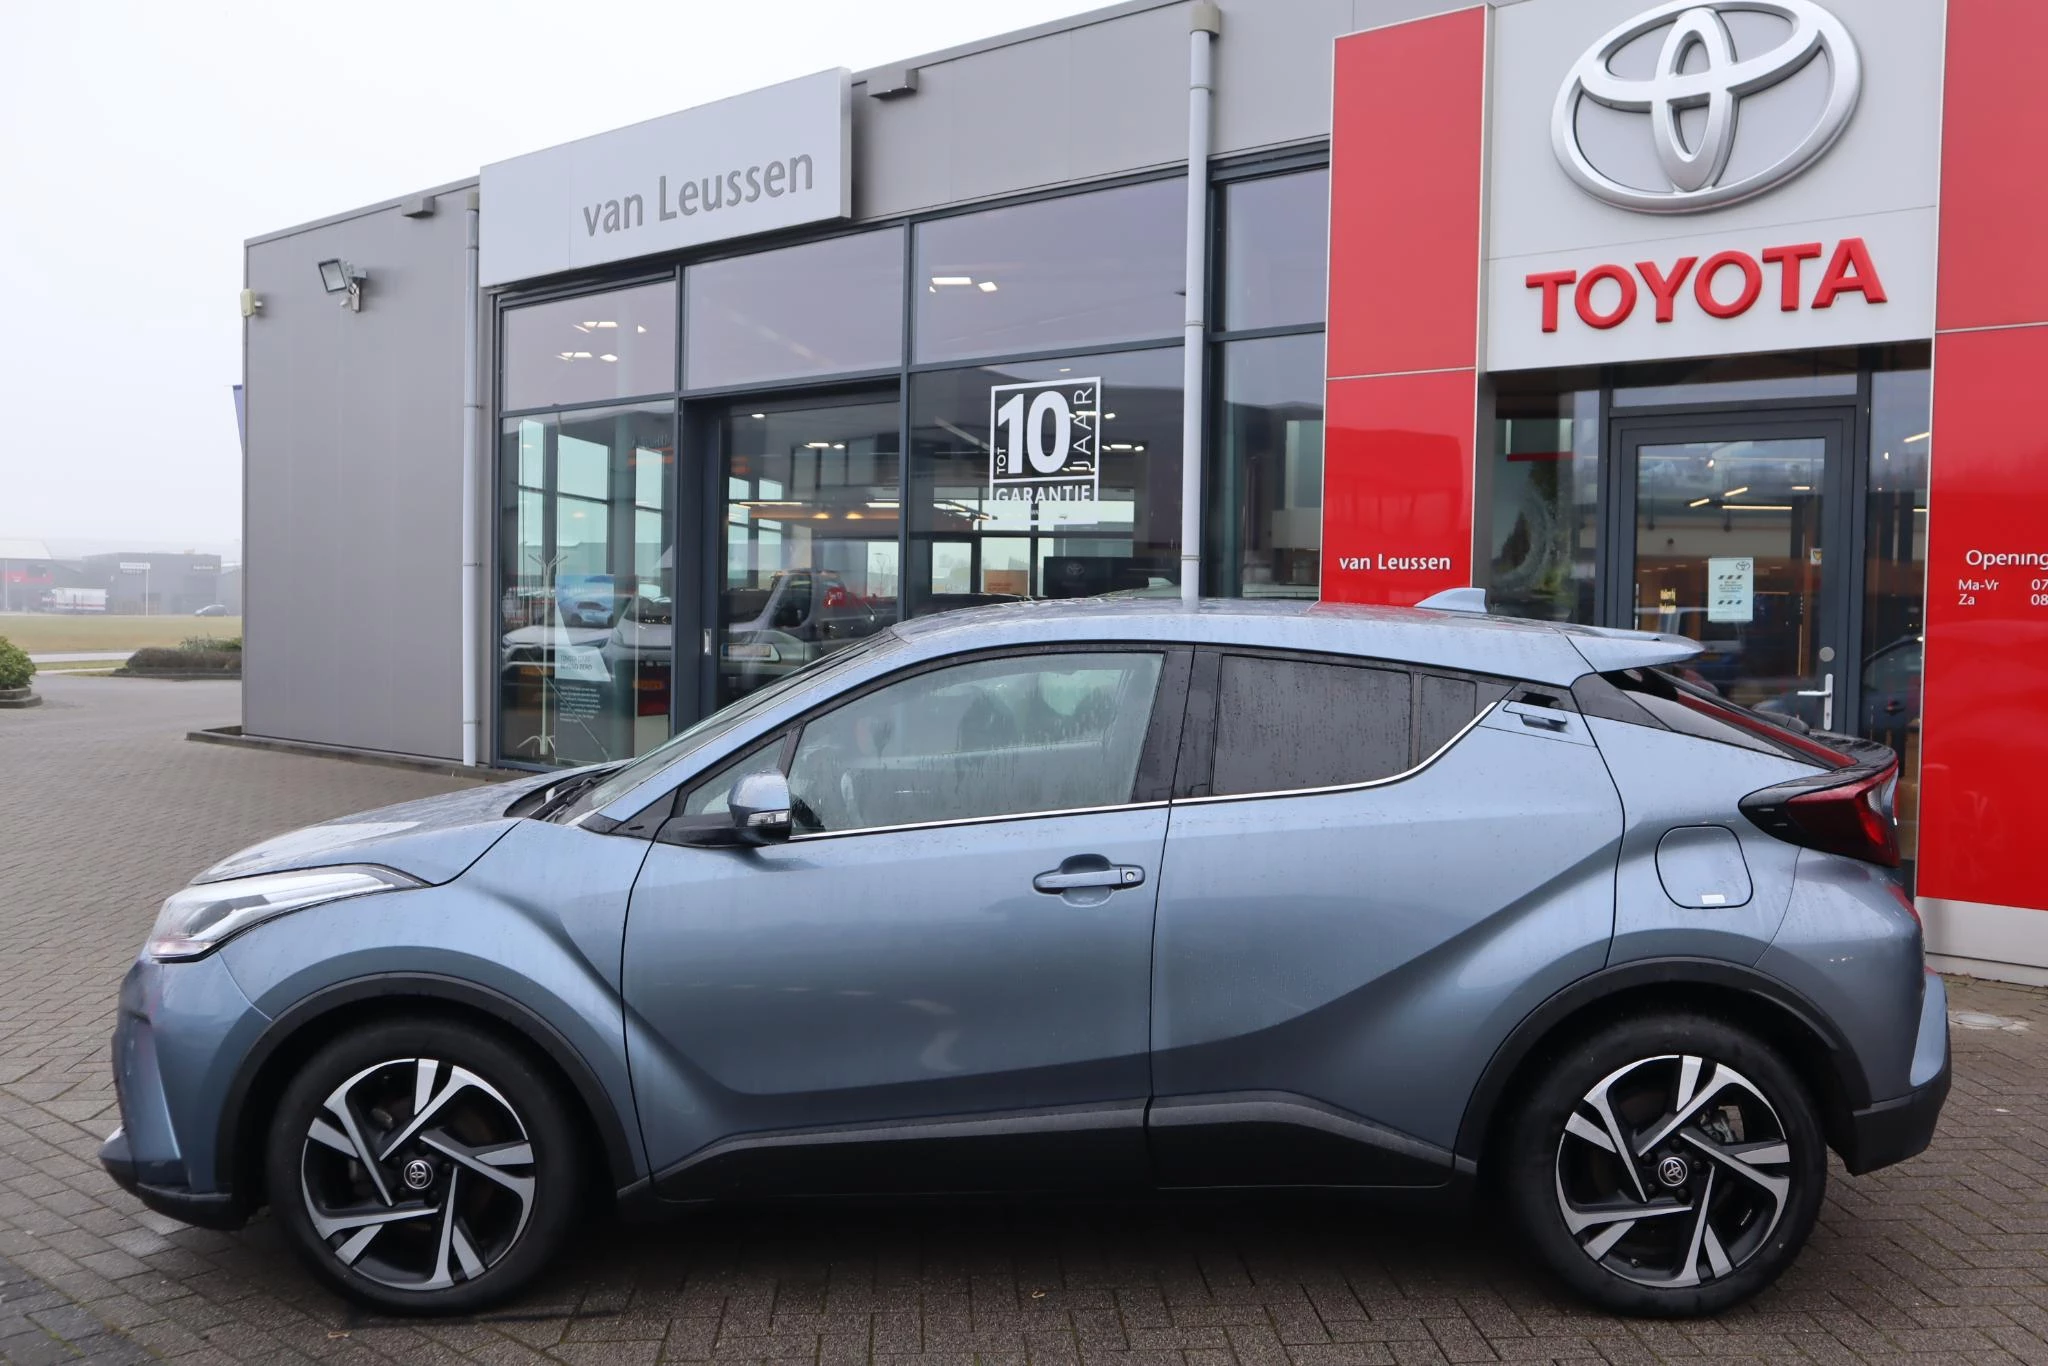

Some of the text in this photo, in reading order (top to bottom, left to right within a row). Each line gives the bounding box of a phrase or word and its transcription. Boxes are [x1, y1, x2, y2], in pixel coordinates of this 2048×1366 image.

[583, 154, 813, 237] van Leussen
[1525, 236, 1888, 333] TOYOTA
[997, 390, 1071, 474] 10
[1072, 387, 1093, 469] JAAR
[996, 447, 1007, 475] TOT
[995, 485, 1091, 505] GARANTIE
[1339, 553, 1451, 570] van Leussen
[1965, 549, 2048, 571] Opening
[1958, 579, 1999, 591] Ma-Vr
[1958, 593, 1975, 606] Za
